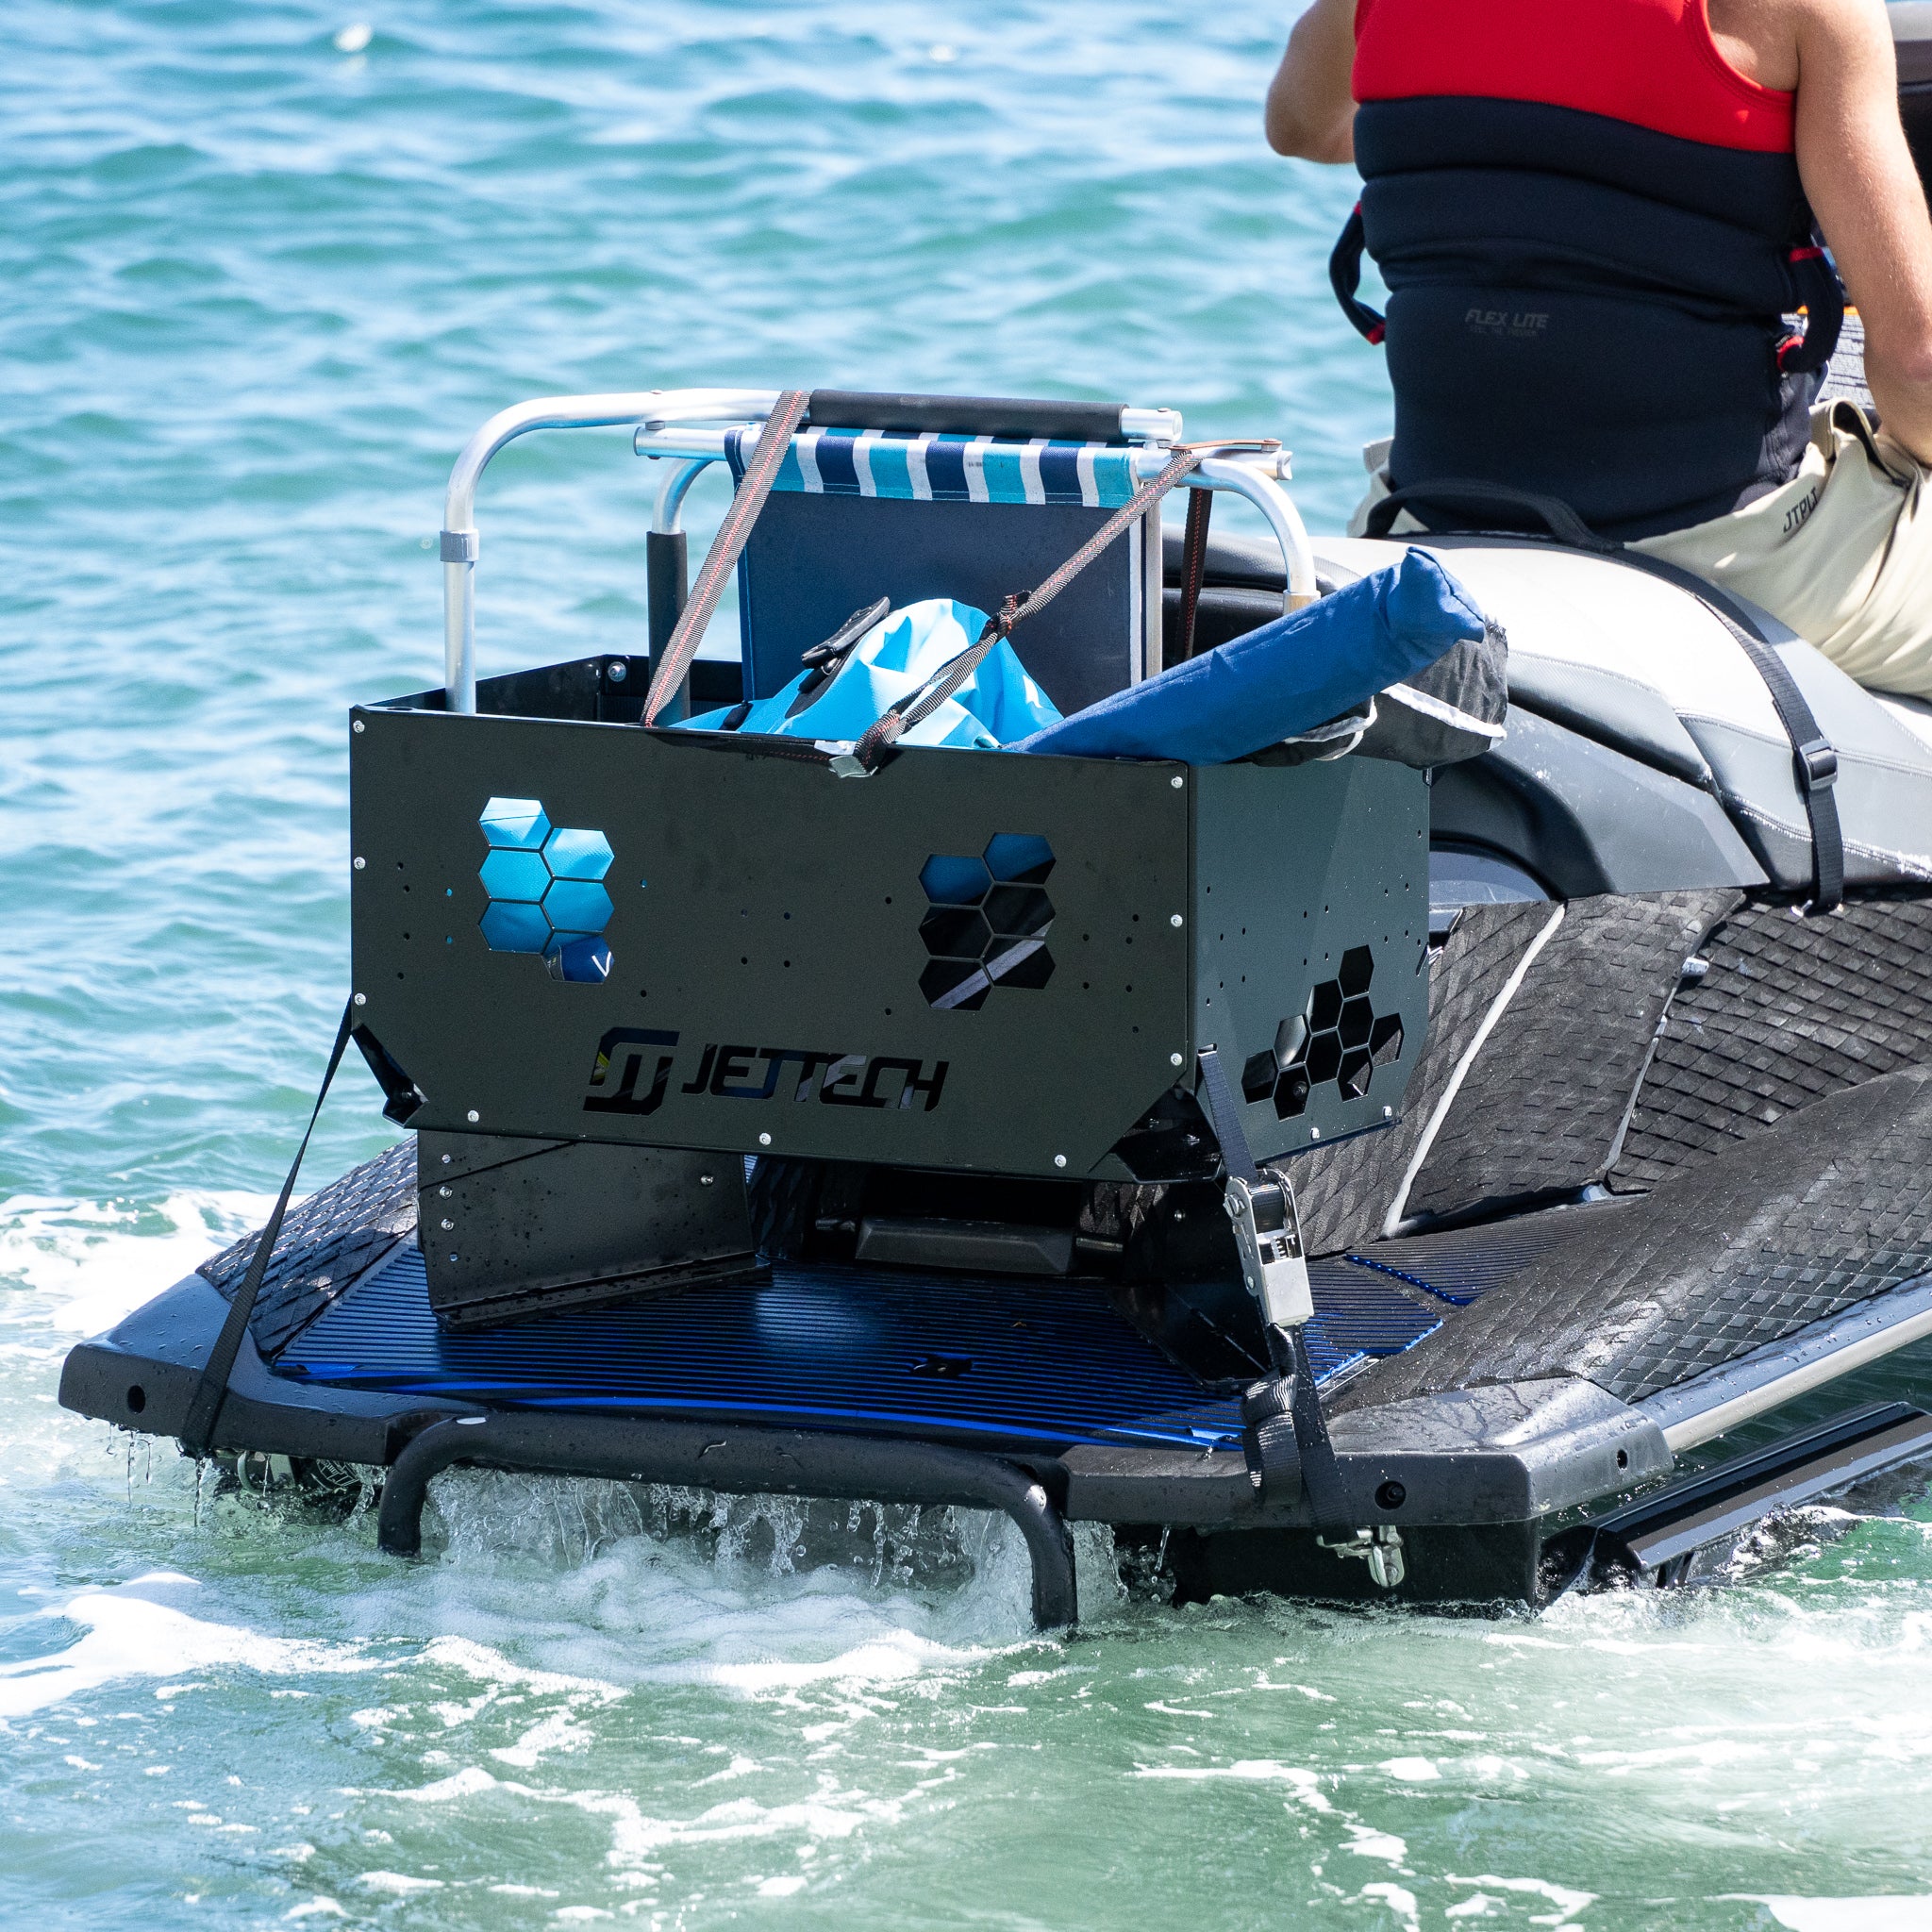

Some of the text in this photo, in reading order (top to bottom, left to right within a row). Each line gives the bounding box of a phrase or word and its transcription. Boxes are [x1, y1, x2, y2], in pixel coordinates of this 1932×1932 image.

[1465, 308, 1550, 328] FLEX LITE
[680, 1042, 950, 1112] JETTECH
